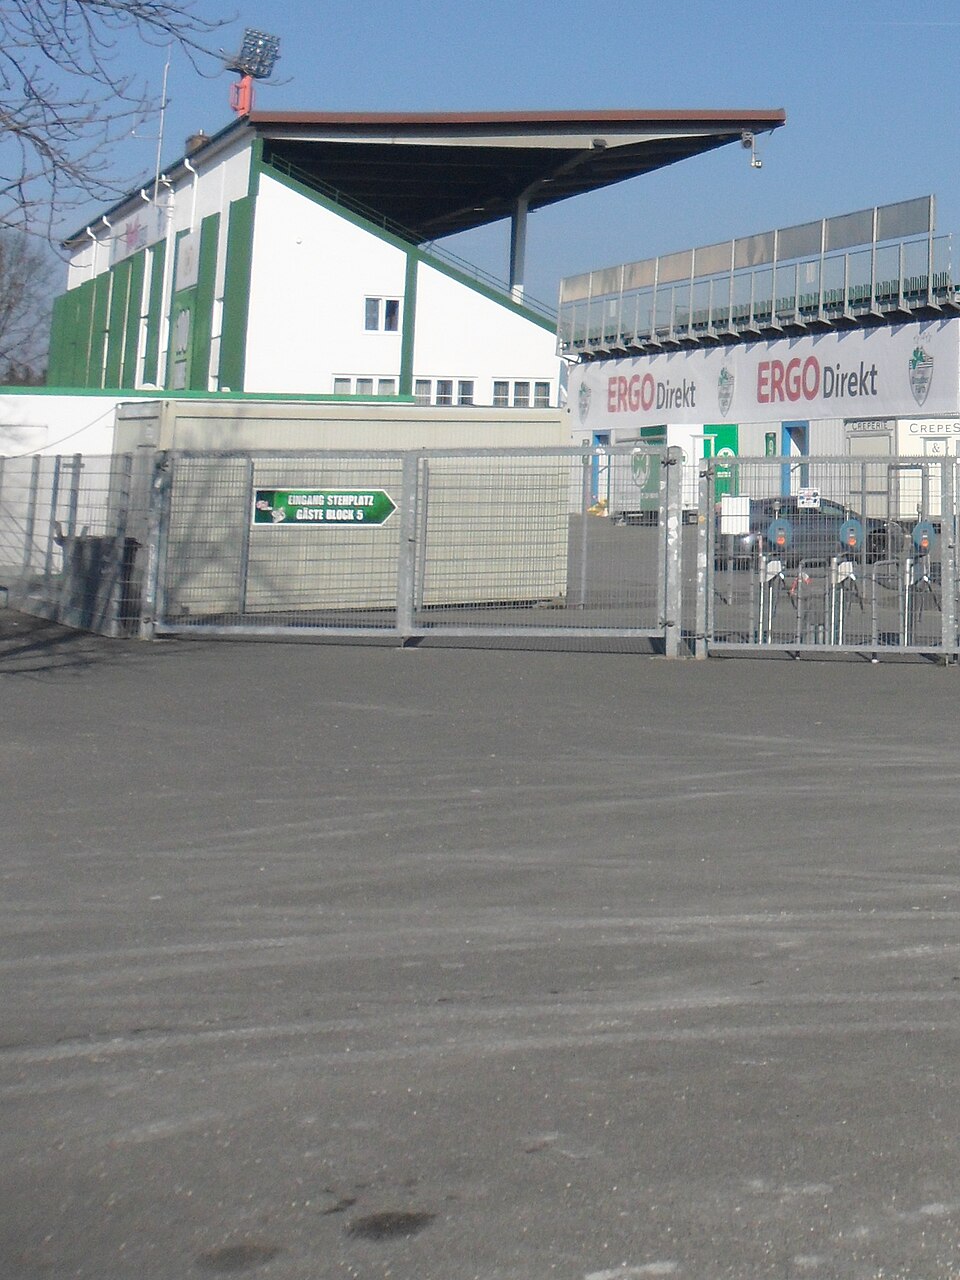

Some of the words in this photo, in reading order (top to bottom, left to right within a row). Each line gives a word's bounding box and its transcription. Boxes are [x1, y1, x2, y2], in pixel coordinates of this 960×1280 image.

[757, 355, 820, 403] ERGO
[823, 361, 878, 398] Direkt
[607, 373, 655, 413] ERGO
[656, 378, 696, 409] Direkt
[932, 442, 940, 453] &
[288, 495, 324, 505] EINGANG
[327, 495, 374, 506] STEHPLATZ
[296, 508, 323, 520] GÄSTE
[326, 509, 353, 520] BLOCK
[356, 510, 363, 520] 5
